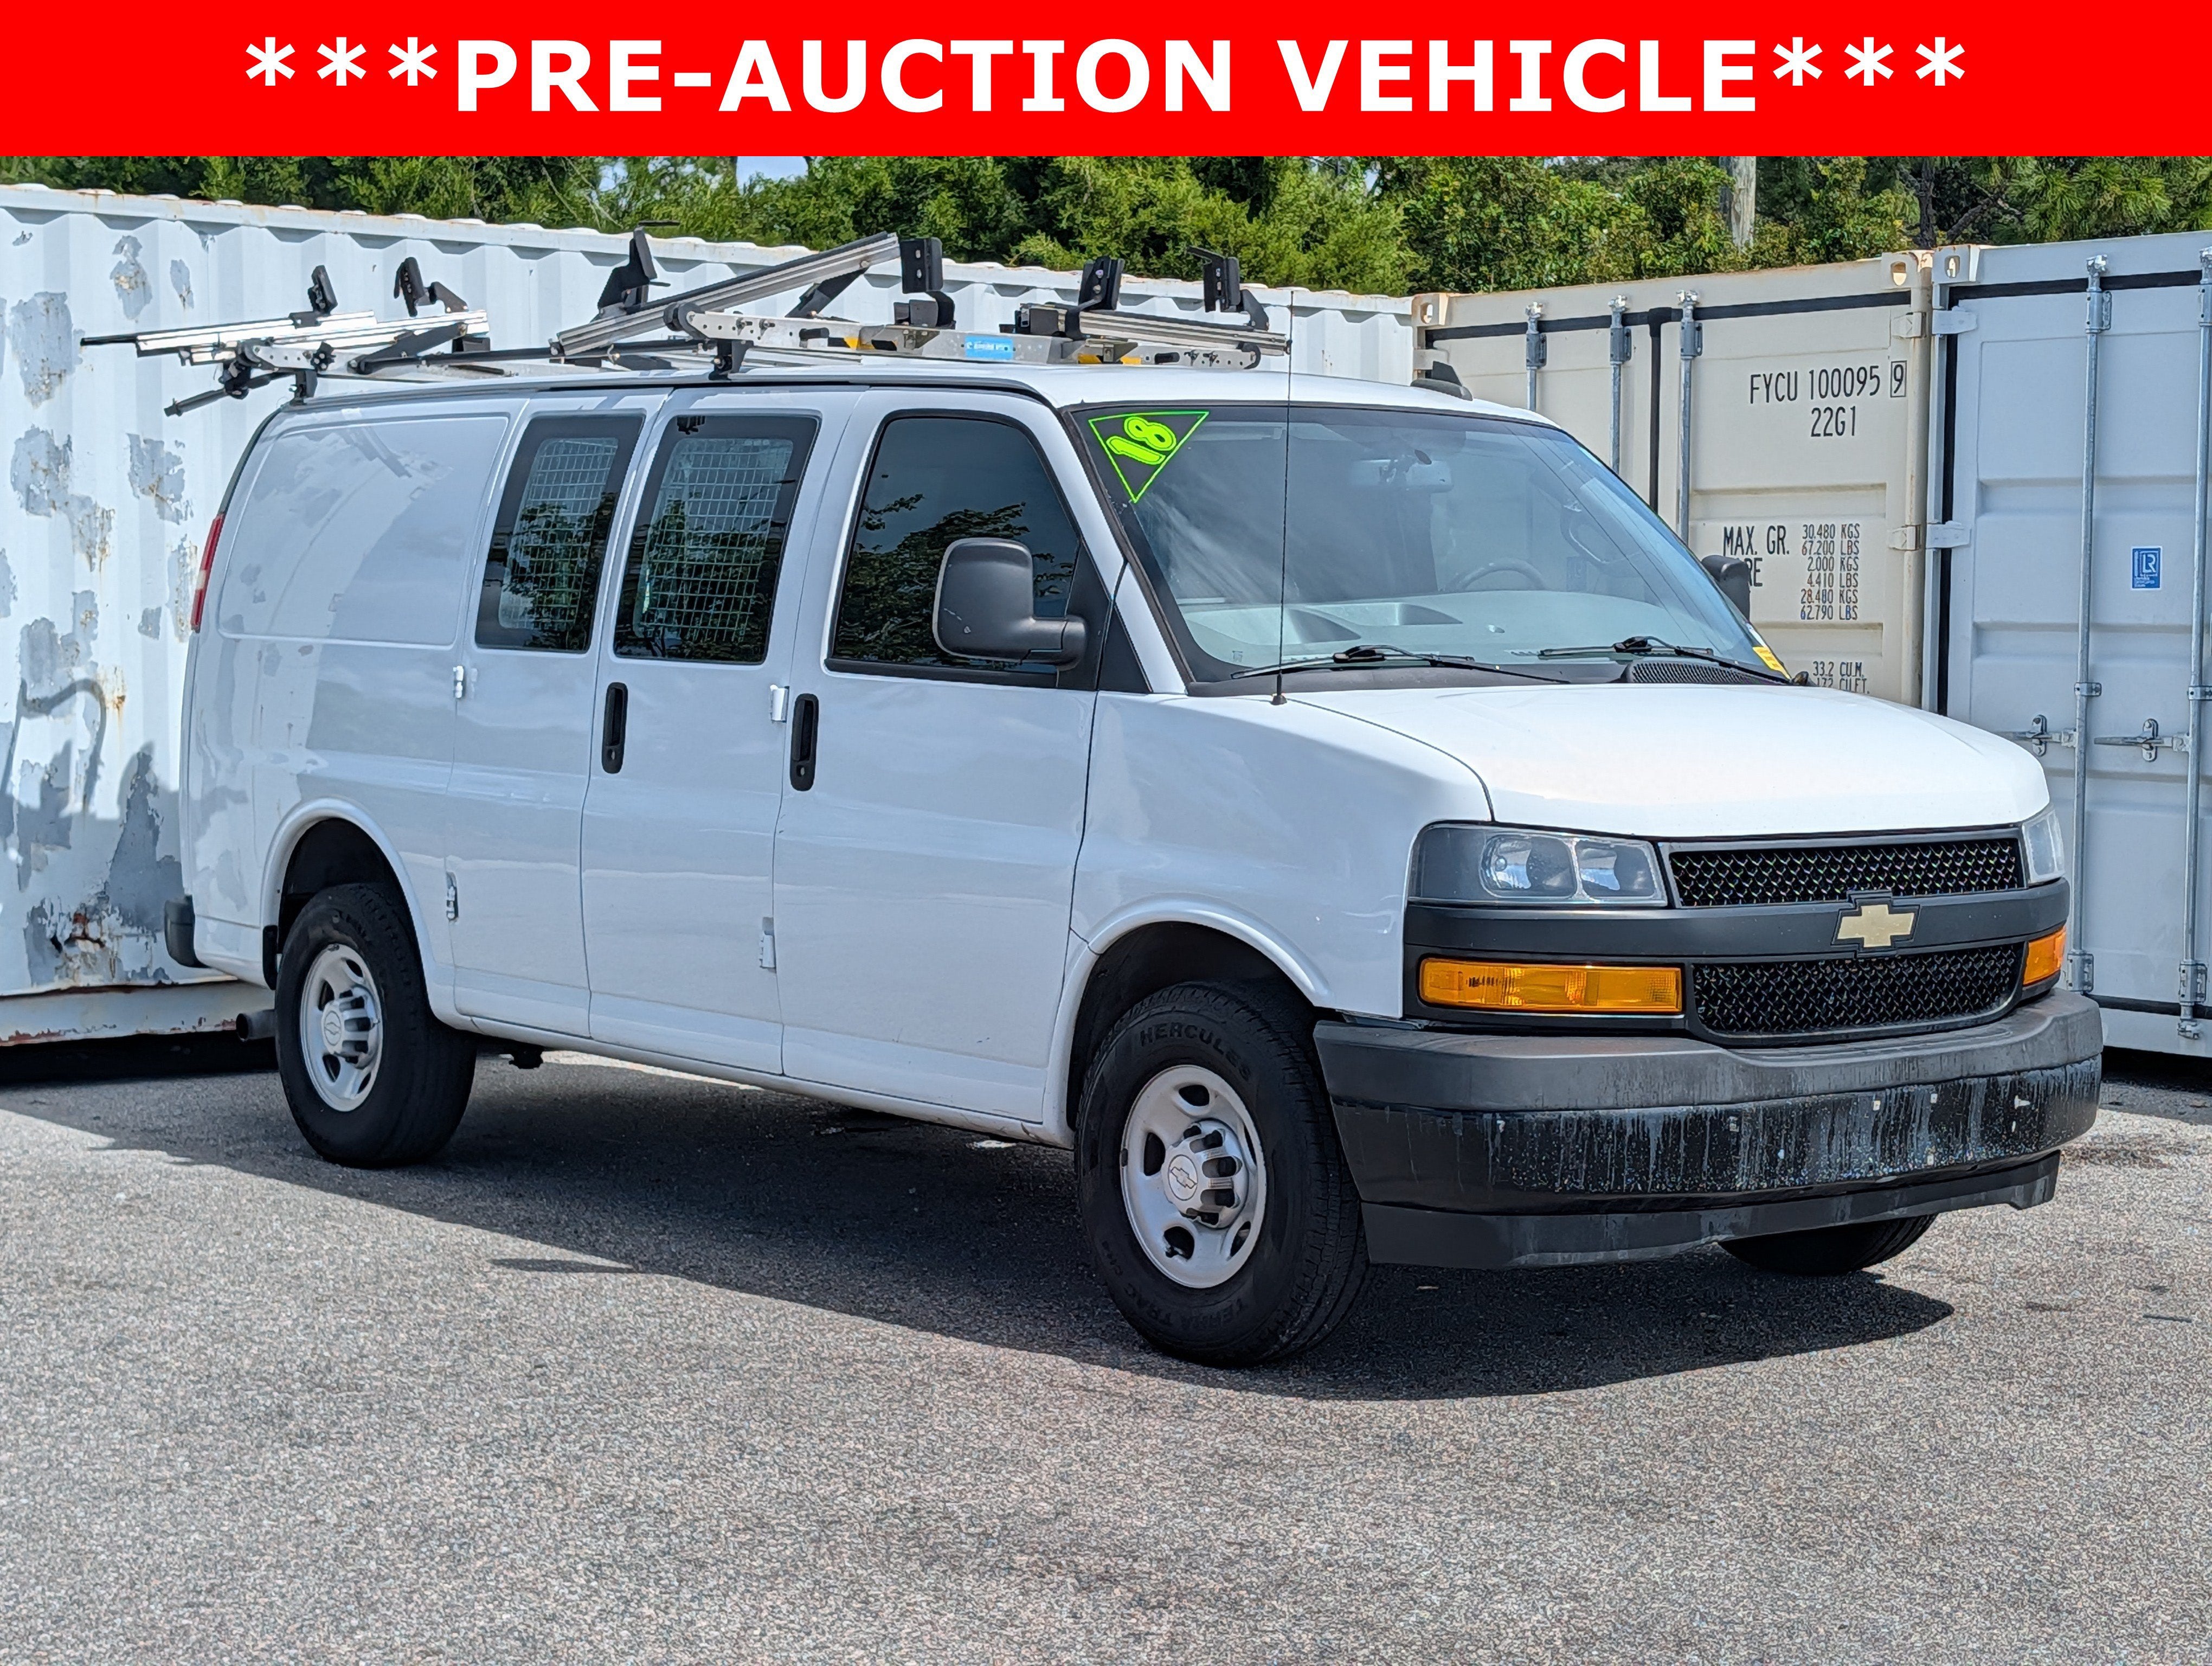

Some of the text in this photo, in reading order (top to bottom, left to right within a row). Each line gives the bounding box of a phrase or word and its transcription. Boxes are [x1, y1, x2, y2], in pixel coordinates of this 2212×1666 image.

[1750, 370, 1798, 404] FYCU
[1809, 365, 1881, 400] 100095
[1810, 406, 1856, 437] 22G1
[1105, 416, 1177, 465] 18
[1723, 523, 1860, 556] MAX. GR. 30.480 KGS
[1801, 540, 1860, 556] 67.200 LBS
[1744, 558, 1763, 587] RE
[1840, 556, 1859, 572] KGS
[2142, 554, 2156, 573] LR
[1839, 572, 1859, 588] LBS
[1801, 588, 1859, 604] 28.480 KGS
[1839, 605, 1858, 620] LBS
[1812, 661, 1835, 677] 33.2
[1140, 1022, 1251, 1081] HERCULES
